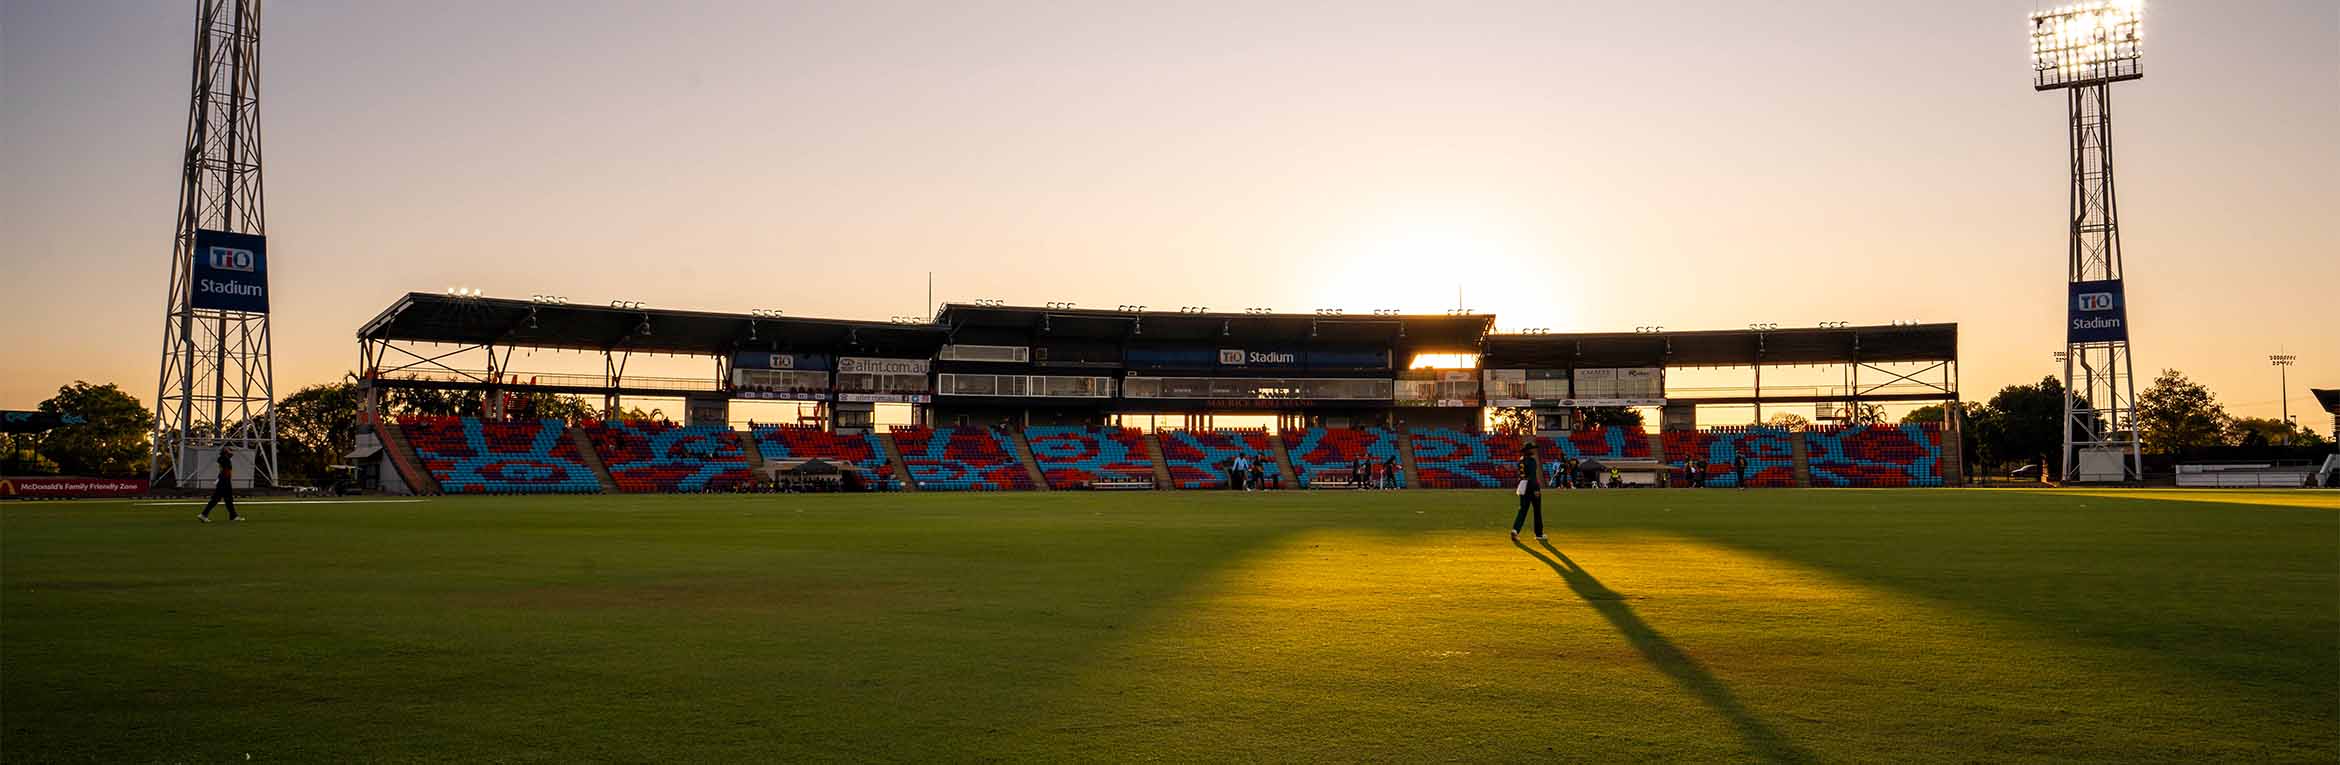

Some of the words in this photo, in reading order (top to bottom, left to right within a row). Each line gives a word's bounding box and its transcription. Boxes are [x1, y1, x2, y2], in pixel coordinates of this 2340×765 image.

[201, 278, 262, 297] Stadium
[2073, 316, 2120, 330] Stadium
[1249, 351, 1294, 363] Stadium
[64, 483, 88, 492] Family
[89, 483, 118, 492] Friendly
